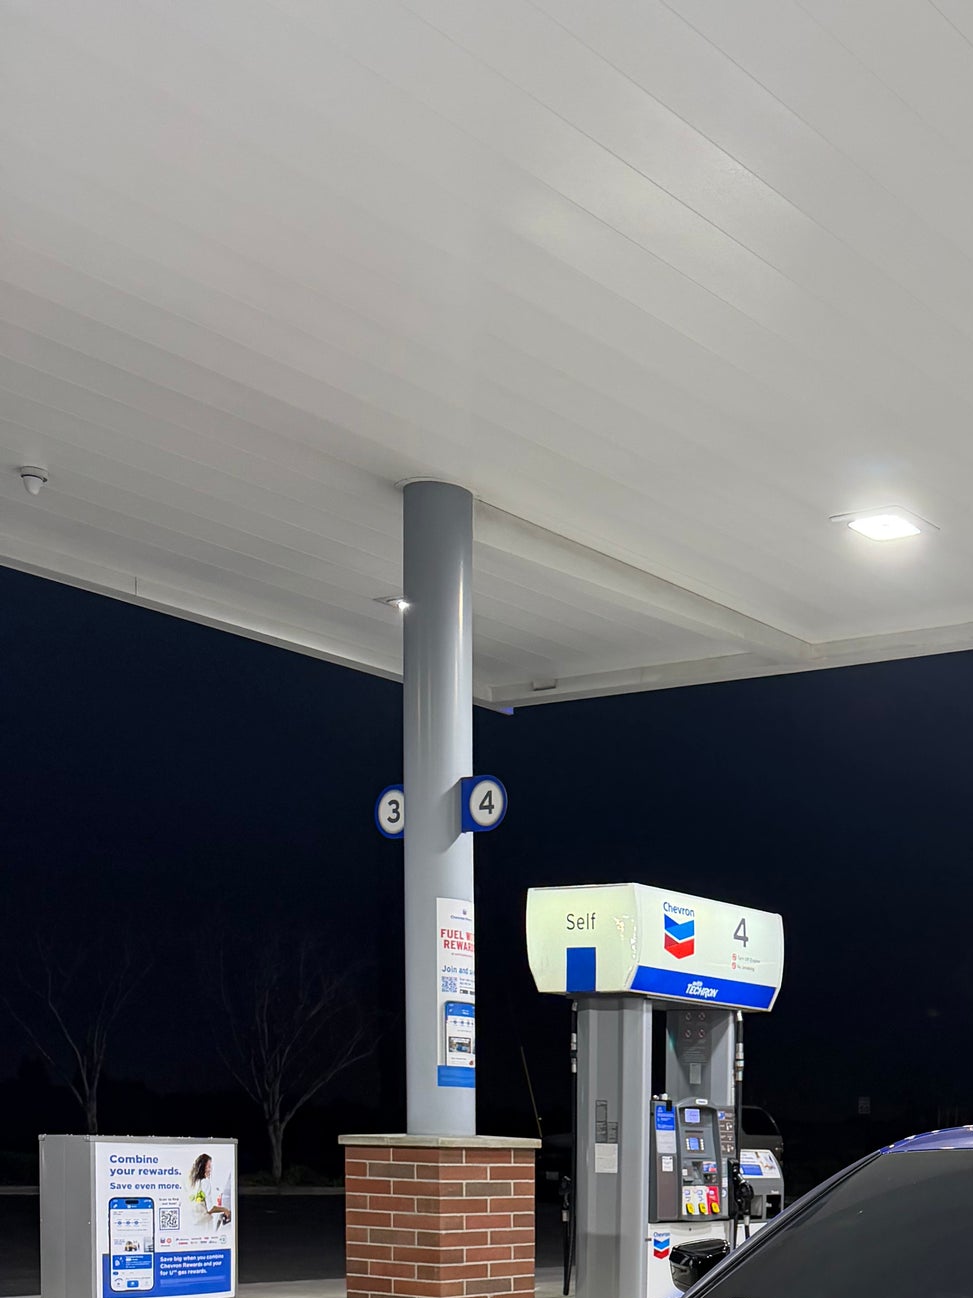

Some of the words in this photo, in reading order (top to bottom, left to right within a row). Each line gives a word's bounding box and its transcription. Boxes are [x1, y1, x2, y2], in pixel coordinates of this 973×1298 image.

[479, 790, 494, 814] 4
[387, 799, 400, 824] 3
[663, 902, 694, 917] Chevron
[566, 913, 596, 930] Self
[440, 928, 464, 940] FUEL
[733, 918, 749, 947] 4
[441, 965, 457, 973] Join
[685, 983, 719, 998] TECHRON
[109, 1154, 159, 1164] Combine
[109, 1168, 135, 1176] your
[138, 1166, 182, 1175] rewards.
[109, 1182, 132, 1190] Save
